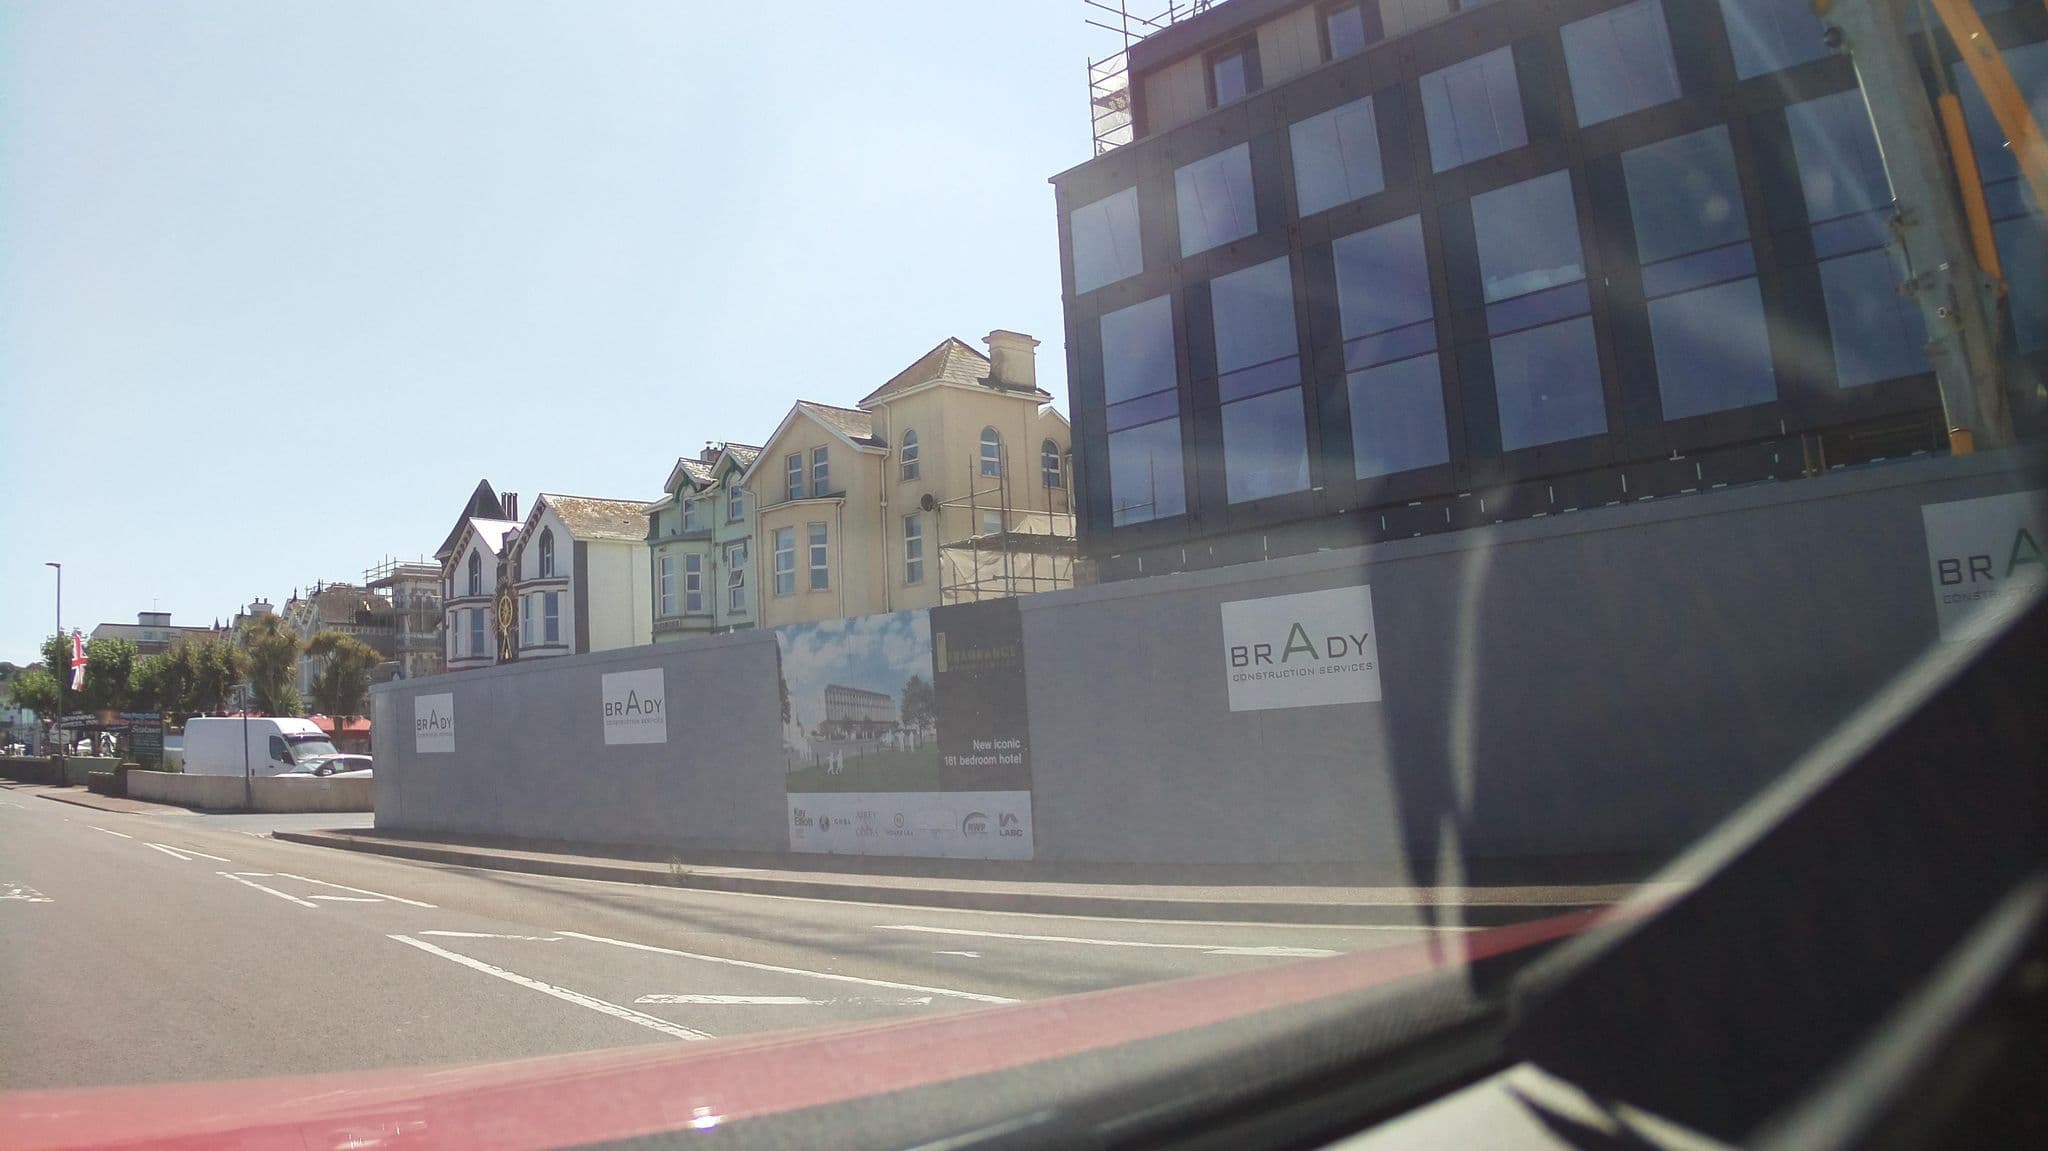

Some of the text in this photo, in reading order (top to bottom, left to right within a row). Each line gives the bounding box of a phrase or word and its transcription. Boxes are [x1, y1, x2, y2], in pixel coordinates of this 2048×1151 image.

[1230, 622, 1369, 668] BRADY
[1232, 662, 1373, 682] CONSTRUCTION SERVICES
[605, 689, 662, 717] BRADY
[416, 709, 452, 731] BRADY
[973, 738, 1021, 750] New iconic
[959, 754, 997, 766] bedroom
[999, 753, 1022, 764] hotel
